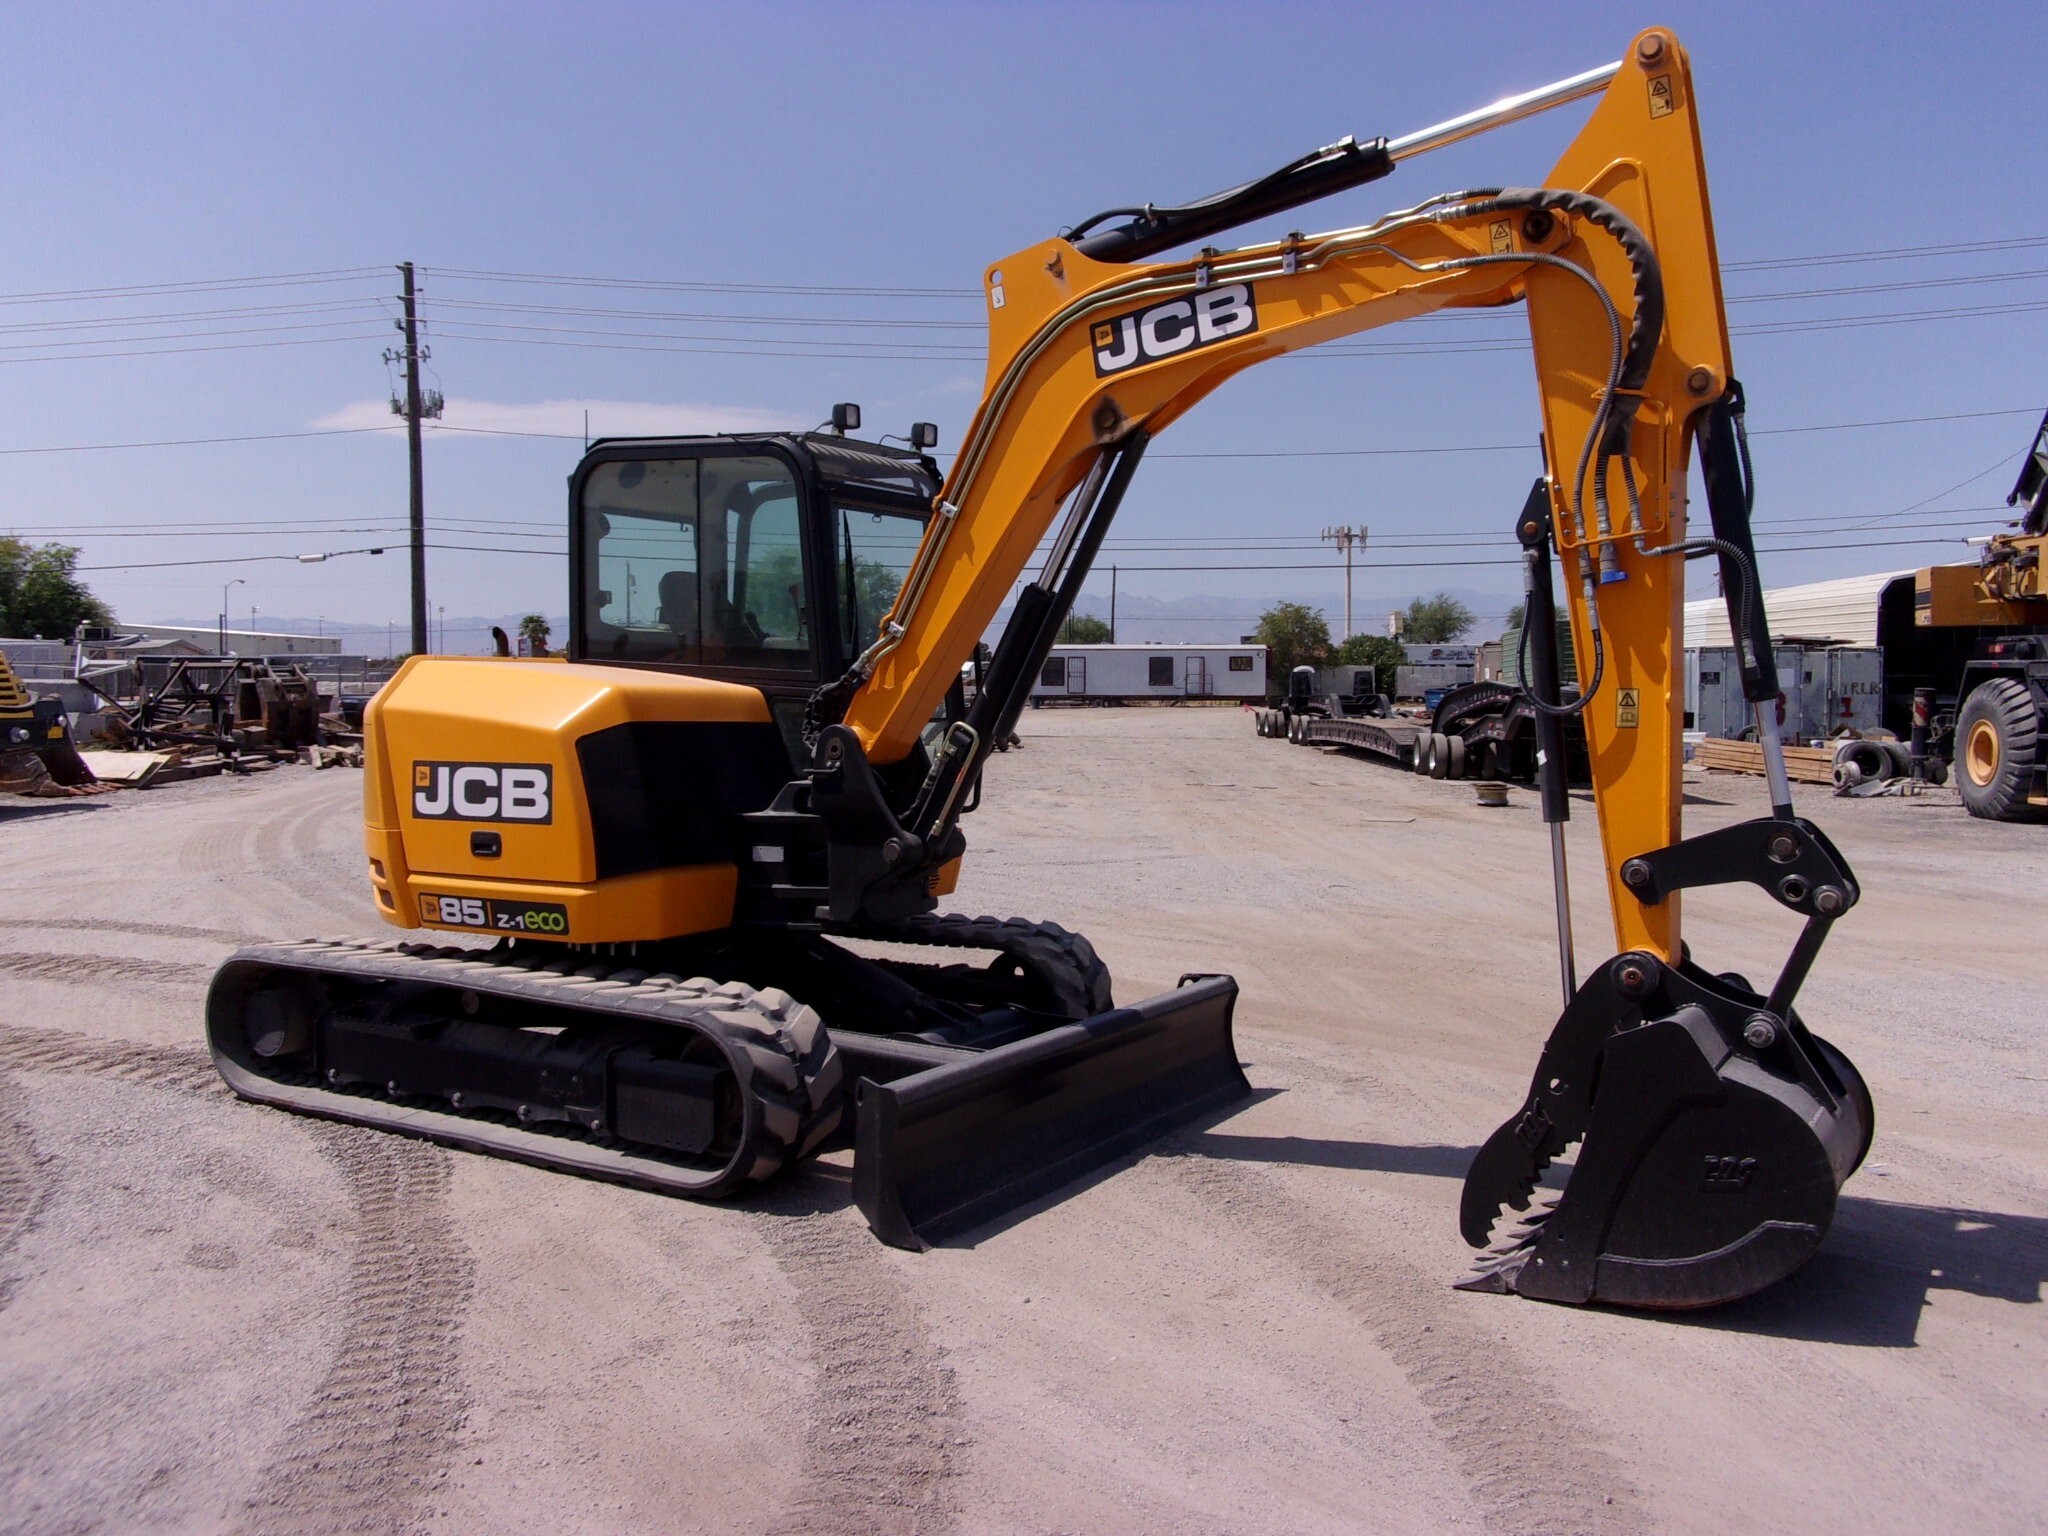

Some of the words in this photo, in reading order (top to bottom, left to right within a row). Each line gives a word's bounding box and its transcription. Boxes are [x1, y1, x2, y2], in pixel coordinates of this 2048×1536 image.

[1097, 284, 1254, 372] JCB
[415, 766, 549, 819] JCB
[438, 897, 486, 926] 85
[524, 910, 565, 932] eco
